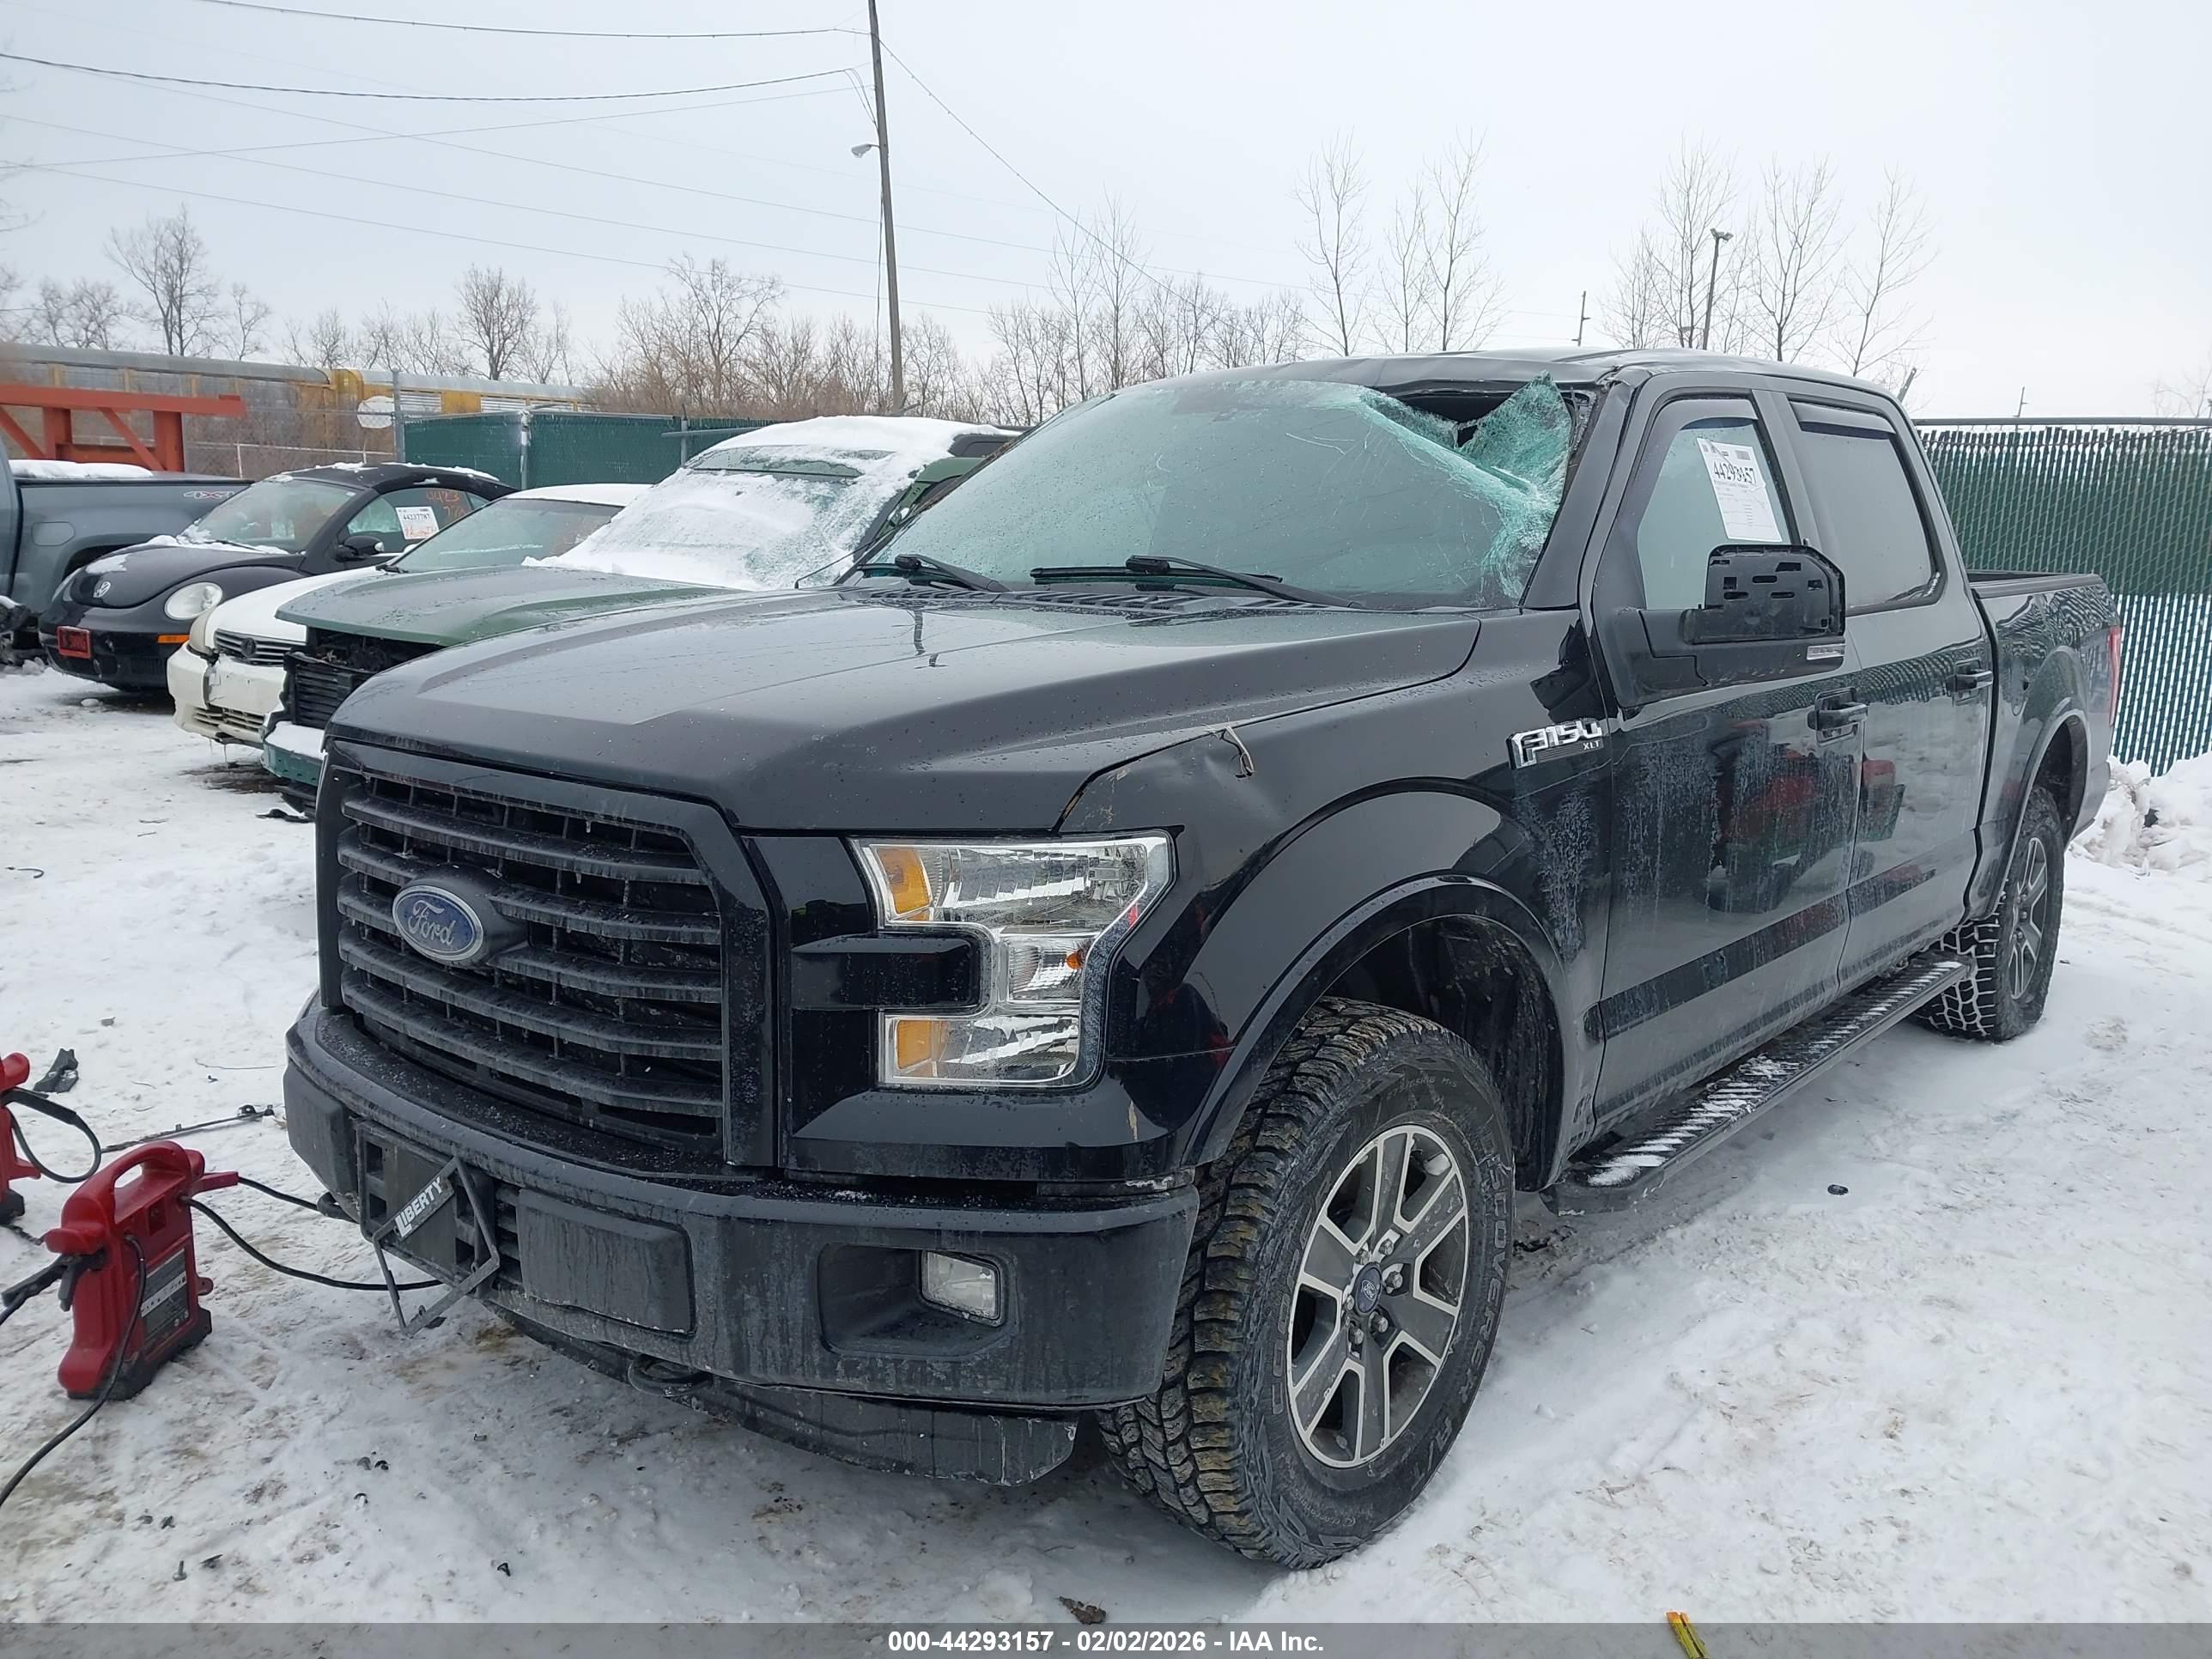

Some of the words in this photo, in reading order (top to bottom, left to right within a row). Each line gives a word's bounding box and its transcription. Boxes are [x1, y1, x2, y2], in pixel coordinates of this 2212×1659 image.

[1713, 459, 1758, 485] 44293157
[1583, 739, 1601, 750] XLT
[408, 899, 457, 946] Ford
[394, 1176, 443, 1238] LIBERTY
